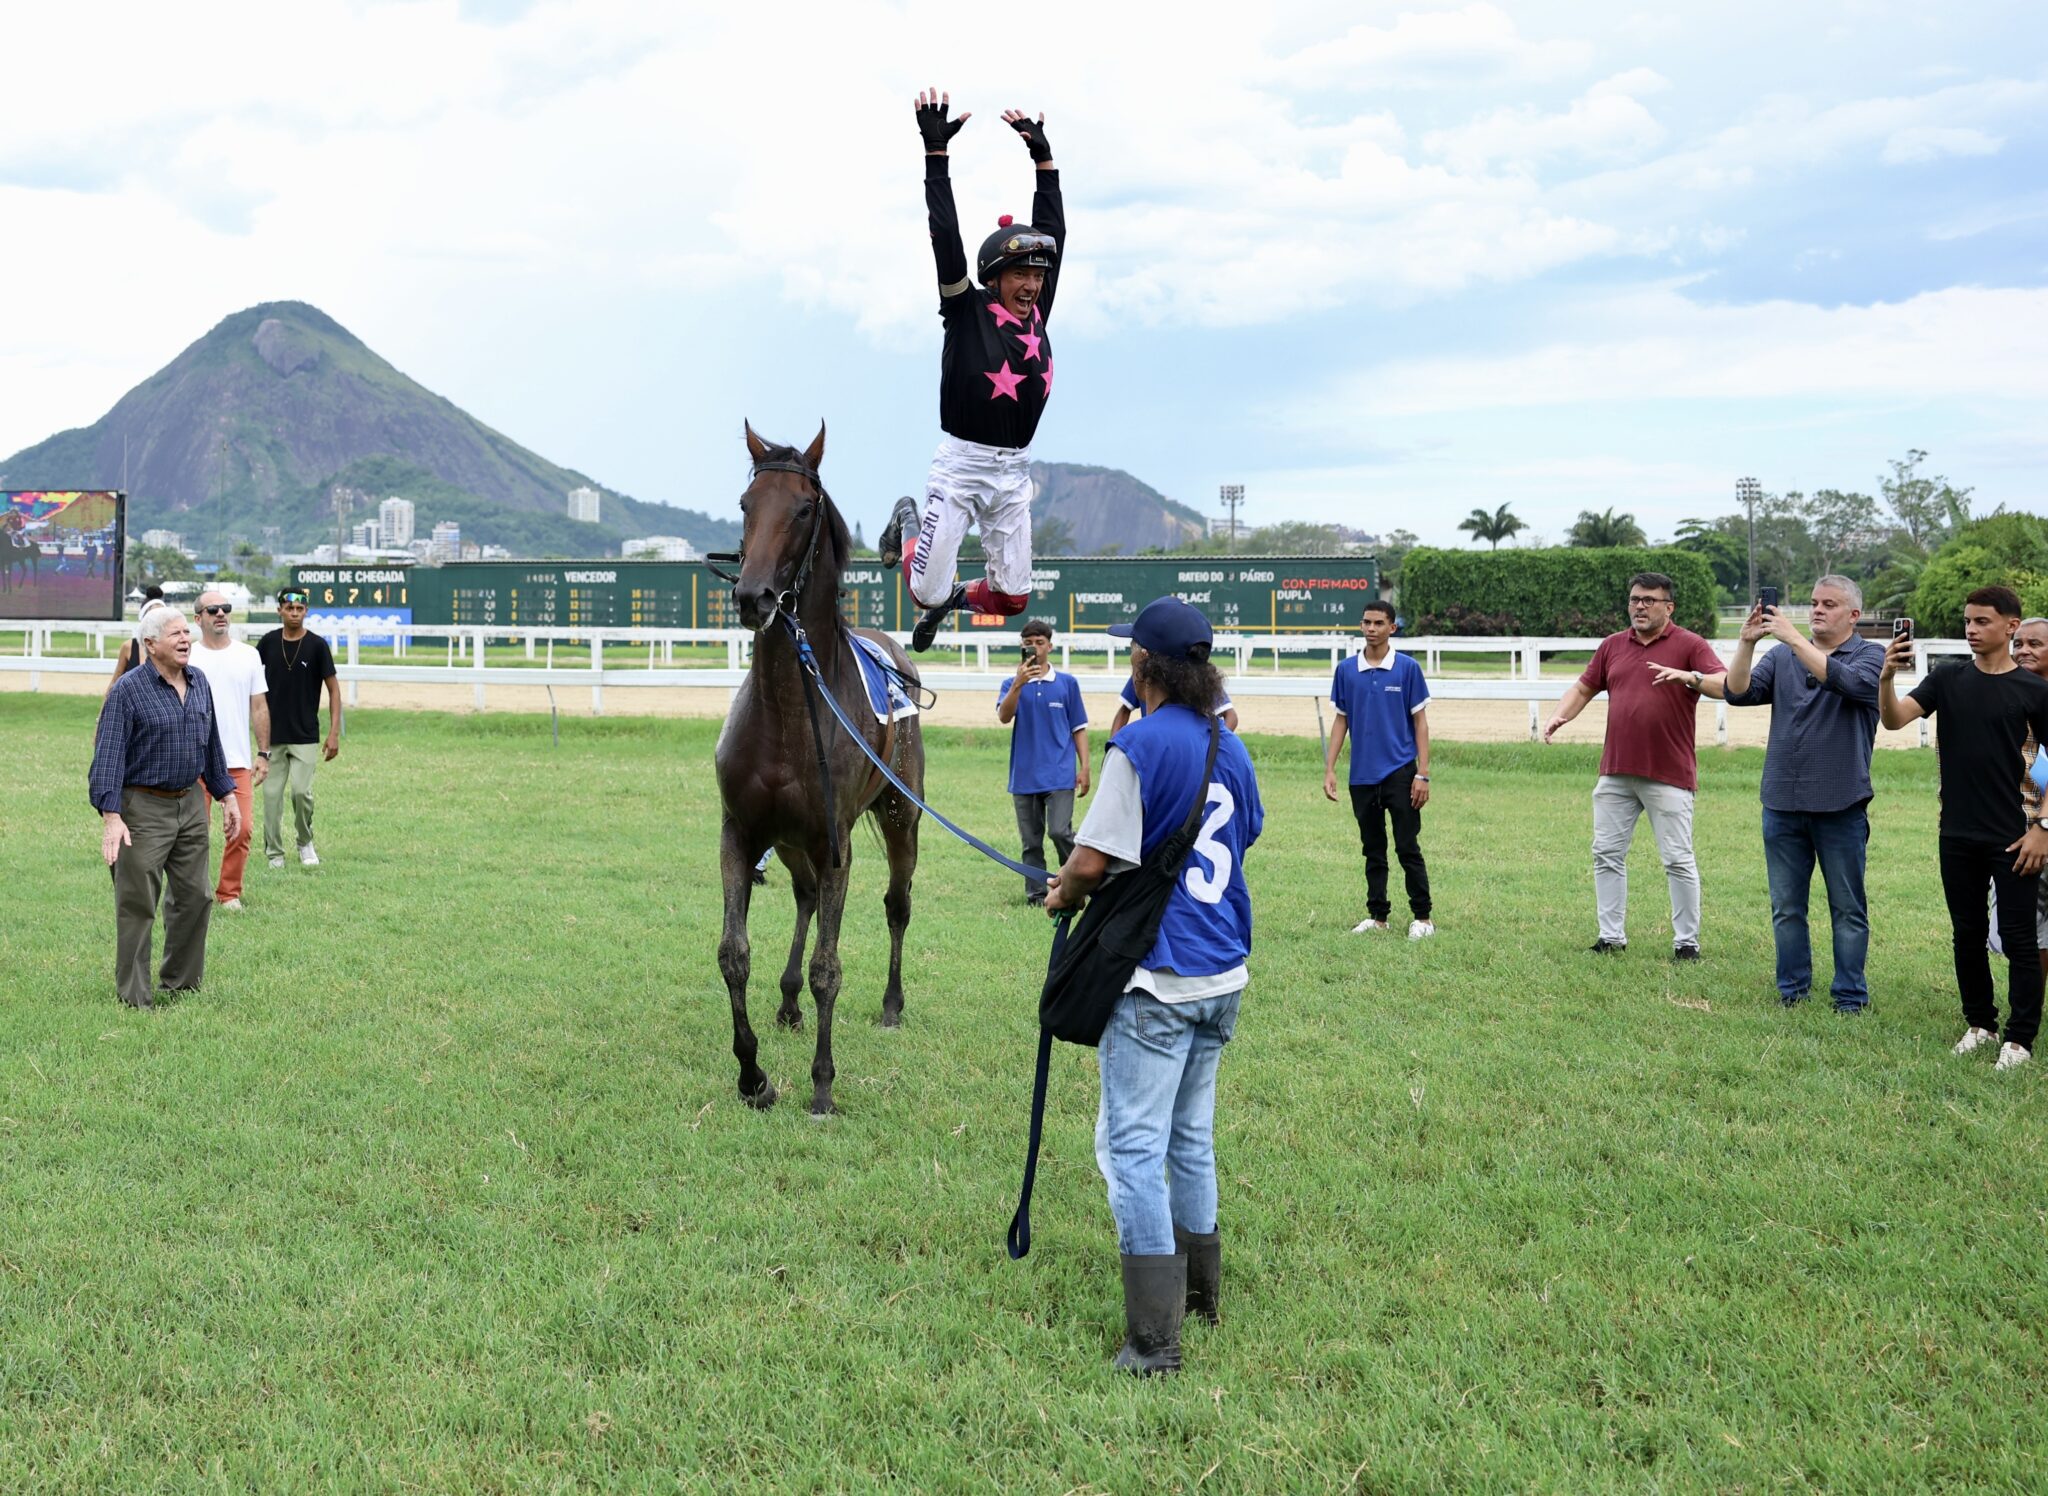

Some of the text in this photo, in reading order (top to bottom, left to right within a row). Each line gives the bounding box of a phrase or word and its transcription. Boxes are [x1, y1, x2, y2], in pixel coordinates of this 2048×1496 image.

[911, 511, 940, 576] DETTORI
[297, 570, 405, 583] ORDEM DE CHEGADA
[564, 571, 617, 583] VENCEDOR
[843, 571, 883, 584] DUPLA
[1031, 568, 1060, 580] RÓXIMO
[1178, 571, 1209, 583] RATEIO
[1210, 571, 1224, 583] DO
[1239, 568, 1275, 583] PÁREO
[1281, 578, 1368, 590] CONFIRMADO
[324, 588, 334, 604] 6
[348, 588, 359, 604] 7
[373, 588, 383, 604] 4
[401, 588, 407, 604] 1
[1075, 593, 1123, 604] VENCEDOR
[1177, 590, 1212, 603] PLACÉ
[1277, 590, 1312, 600] DUPLA
[1185, 782, 1234, 904] 3
